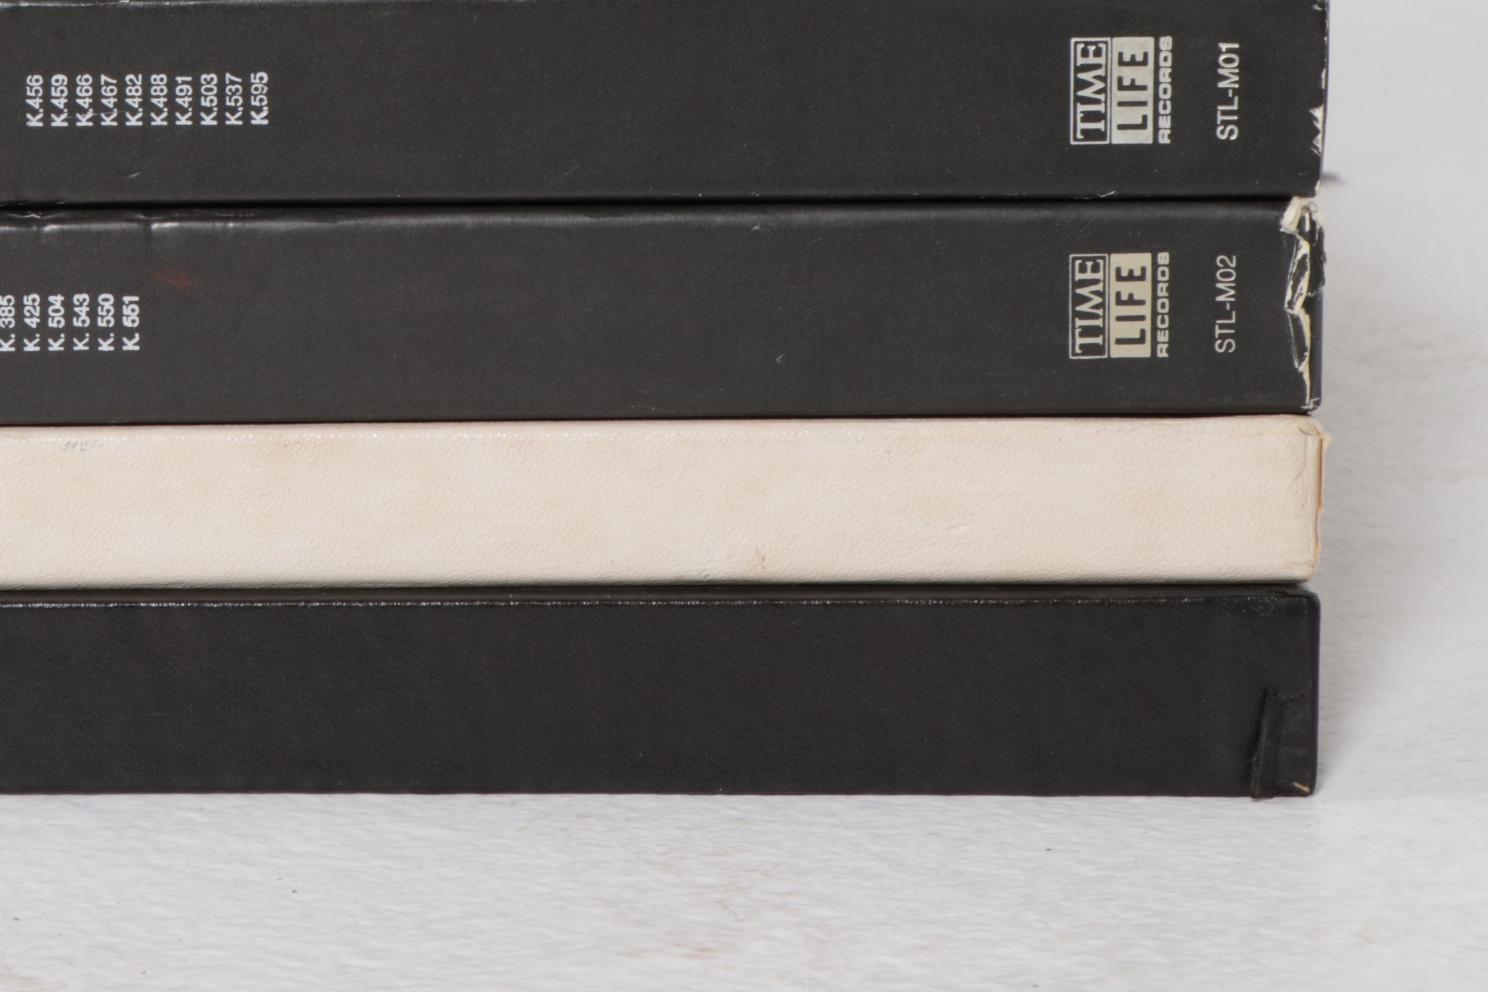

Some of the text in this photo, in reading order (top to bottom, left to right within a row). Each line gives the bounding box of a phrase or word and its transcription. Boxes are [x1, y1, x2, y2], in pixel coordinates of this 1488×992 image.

[1075, 41, 1108, 141] TIME
[1115, 50, 1150, 132] LIFE
[1157, 35, 1174, 145] RECORDS
[1215, 41, 1241, 142] STL-M01
[1074, 258, 1106, 356] TIME
[1114, 265, 1148, 347] LIFE
[1155, 251, 1171, 360] RECORDS
[1213, 254, 1238, 355] STL-M02
